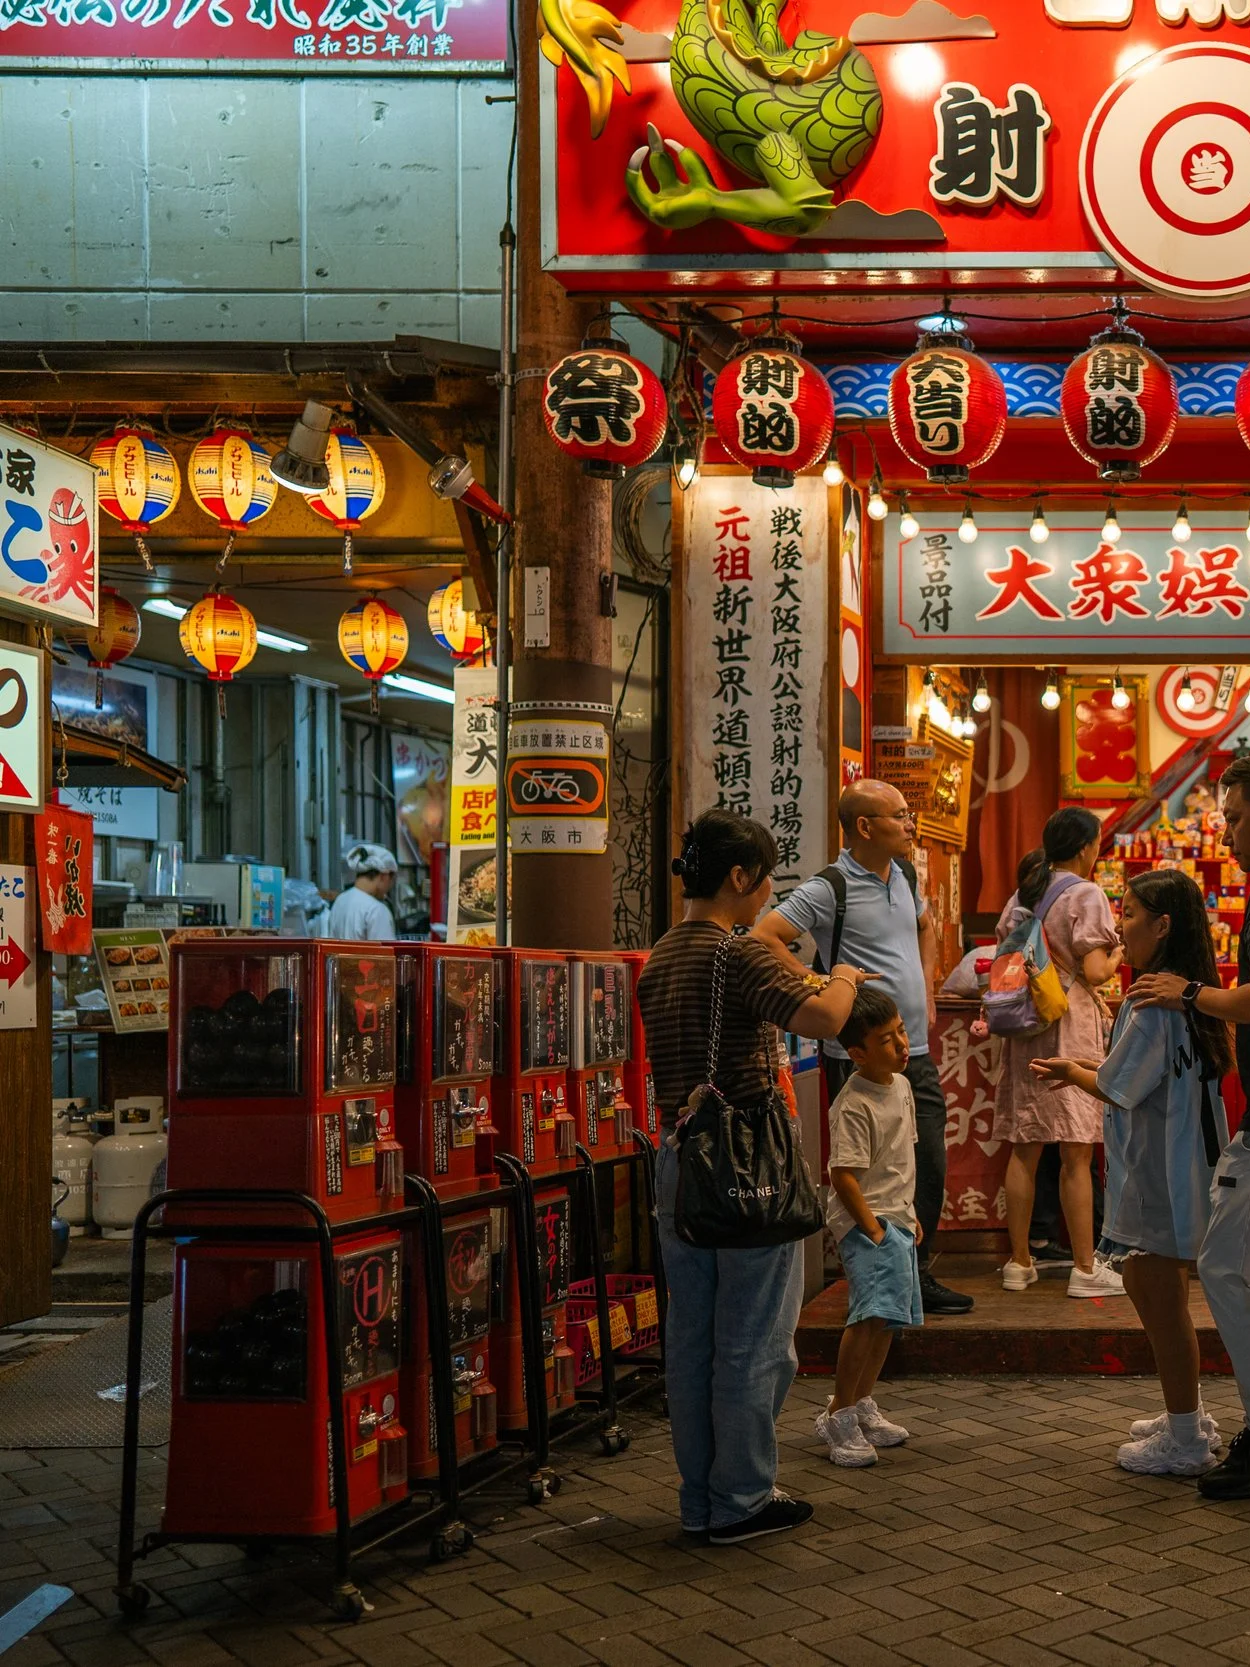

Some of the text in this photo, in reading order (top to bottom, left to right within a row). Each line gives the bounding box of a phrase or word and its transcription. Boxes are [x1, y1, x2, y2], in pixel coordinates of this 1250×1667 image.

[293, 34, 453, 57] 昭和35年創業
[931, 84, 1050, 205] 射
[1188, 149, 1229, 192] 当
[547, 353, 641, 443] 祭
[741, 352, 796, 452] 射的
[909, 353, 965, 450] 大当り
[1091, 350, 1143, 446] 射的
[124, 445, 137, 496] アサヒビール
[151, 473, 173, 483] Asahi
[195, 467, 217, 476] Asahi
[231, 445, 243, 496] アサヒビール
[349, 466, 372, 476] Asahi
[919, 533, 952, 633] 景品付
[46, 822, 59, 865] 味一番
[461, 831, 494, 841] Eating and
[520, 830, 582, 845] 大阪市
[727, 1184, 780, 1199] CHANEL
